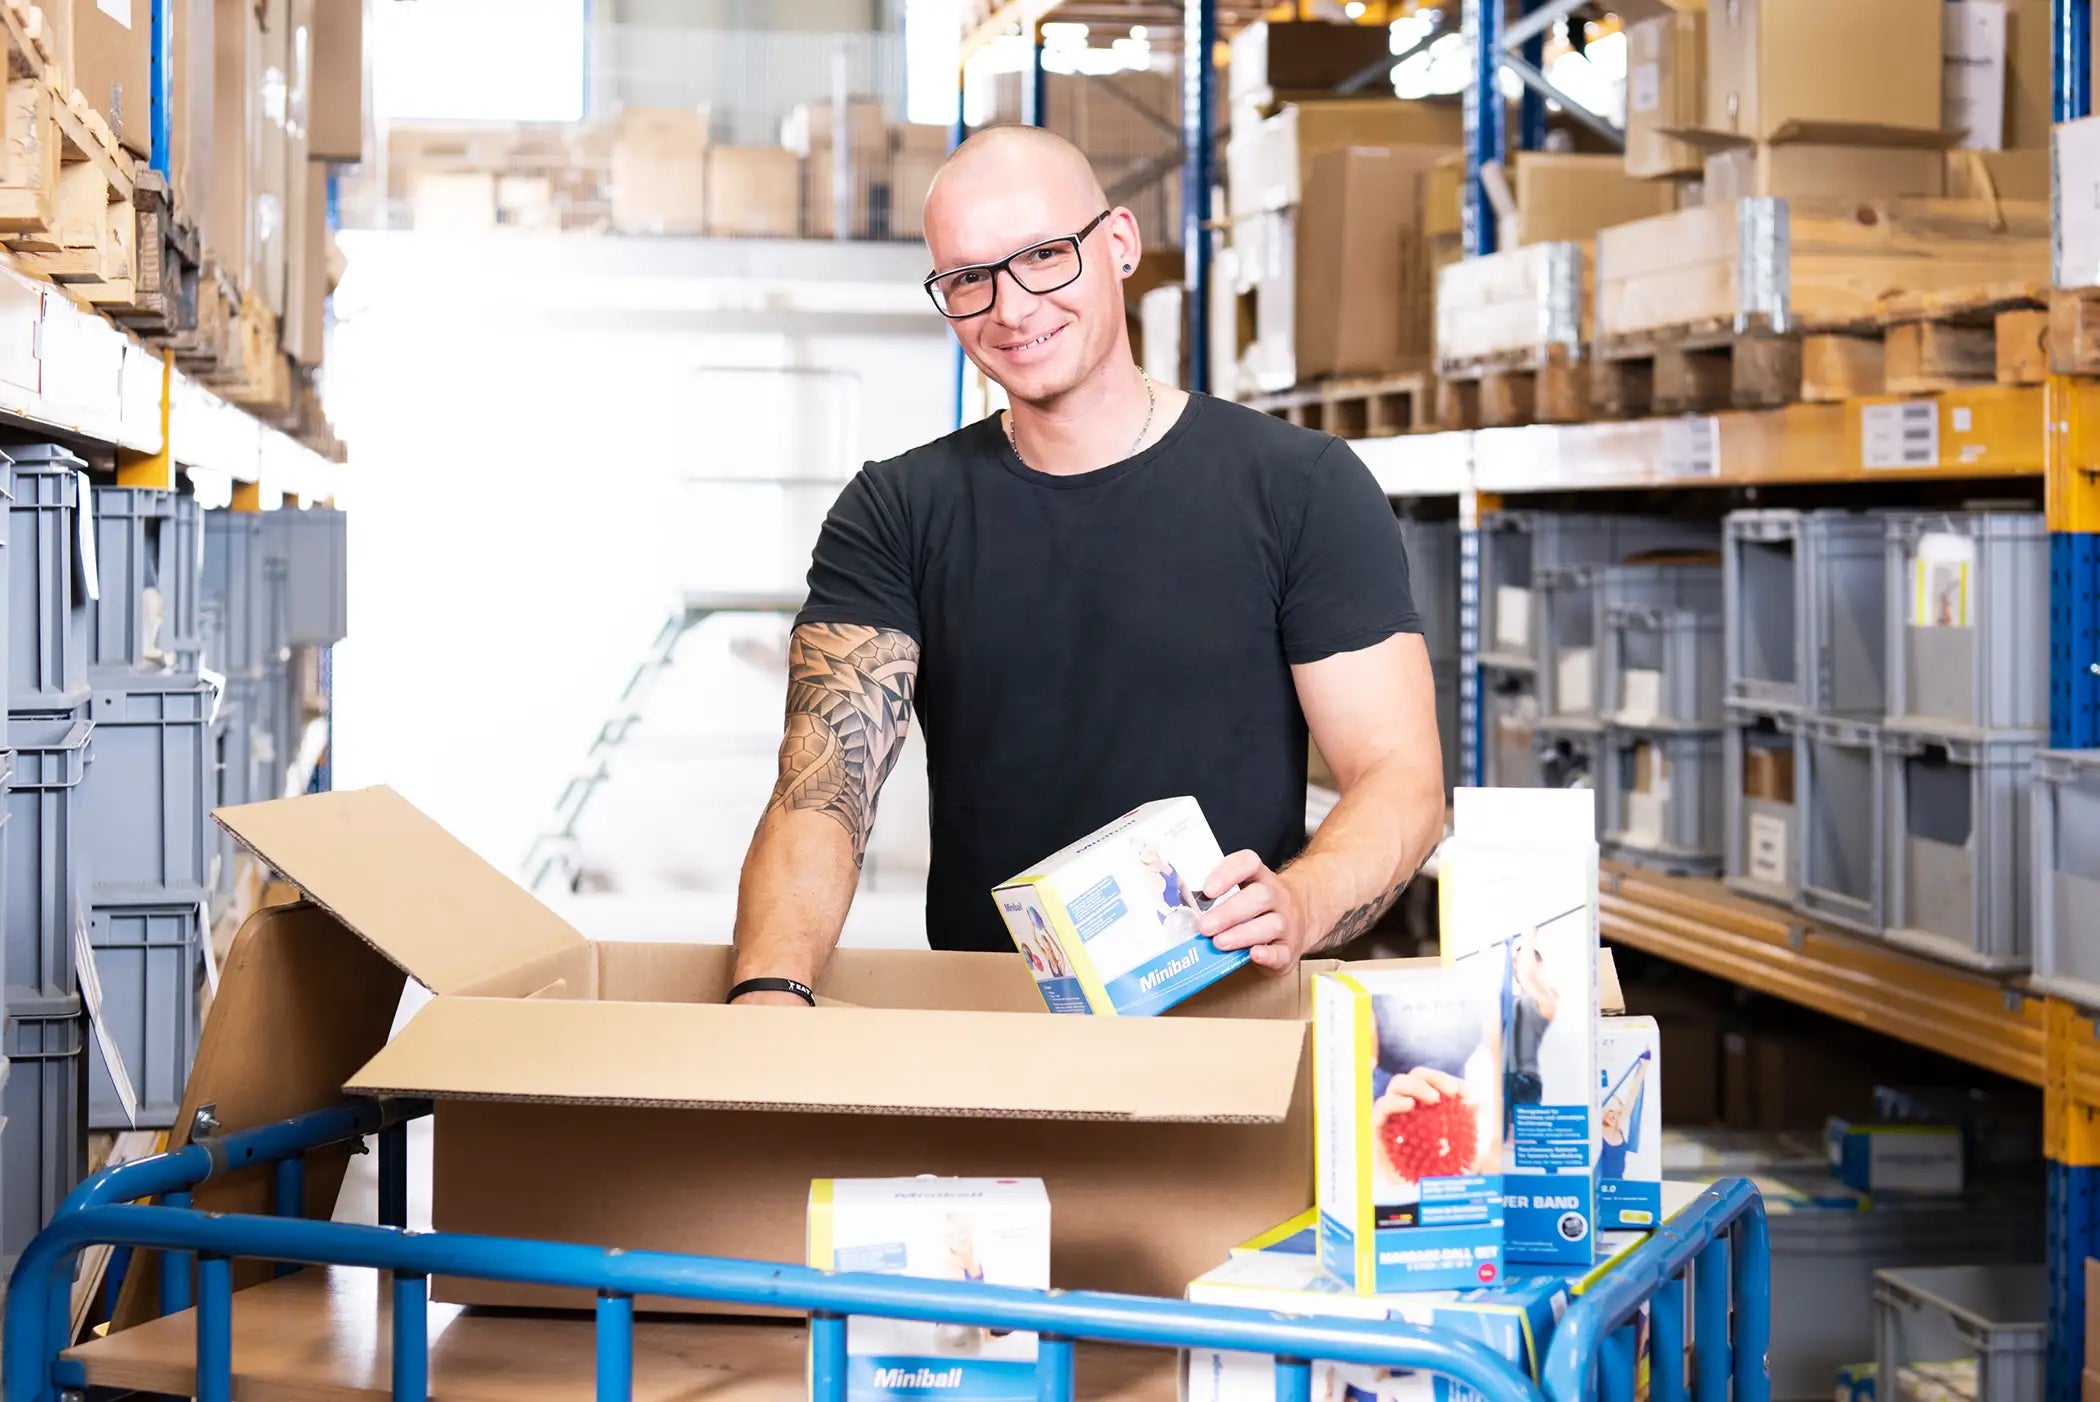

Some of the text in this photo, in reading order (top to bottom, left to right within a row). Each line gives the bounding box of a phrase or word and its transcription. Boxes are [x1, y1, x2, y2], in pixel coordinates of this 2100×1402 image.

[1138, 947, 1200, 992] Miniball
[1533, 1195, 1579, 1209] BAND
[873, 1367, 963, 1388] Miniball
